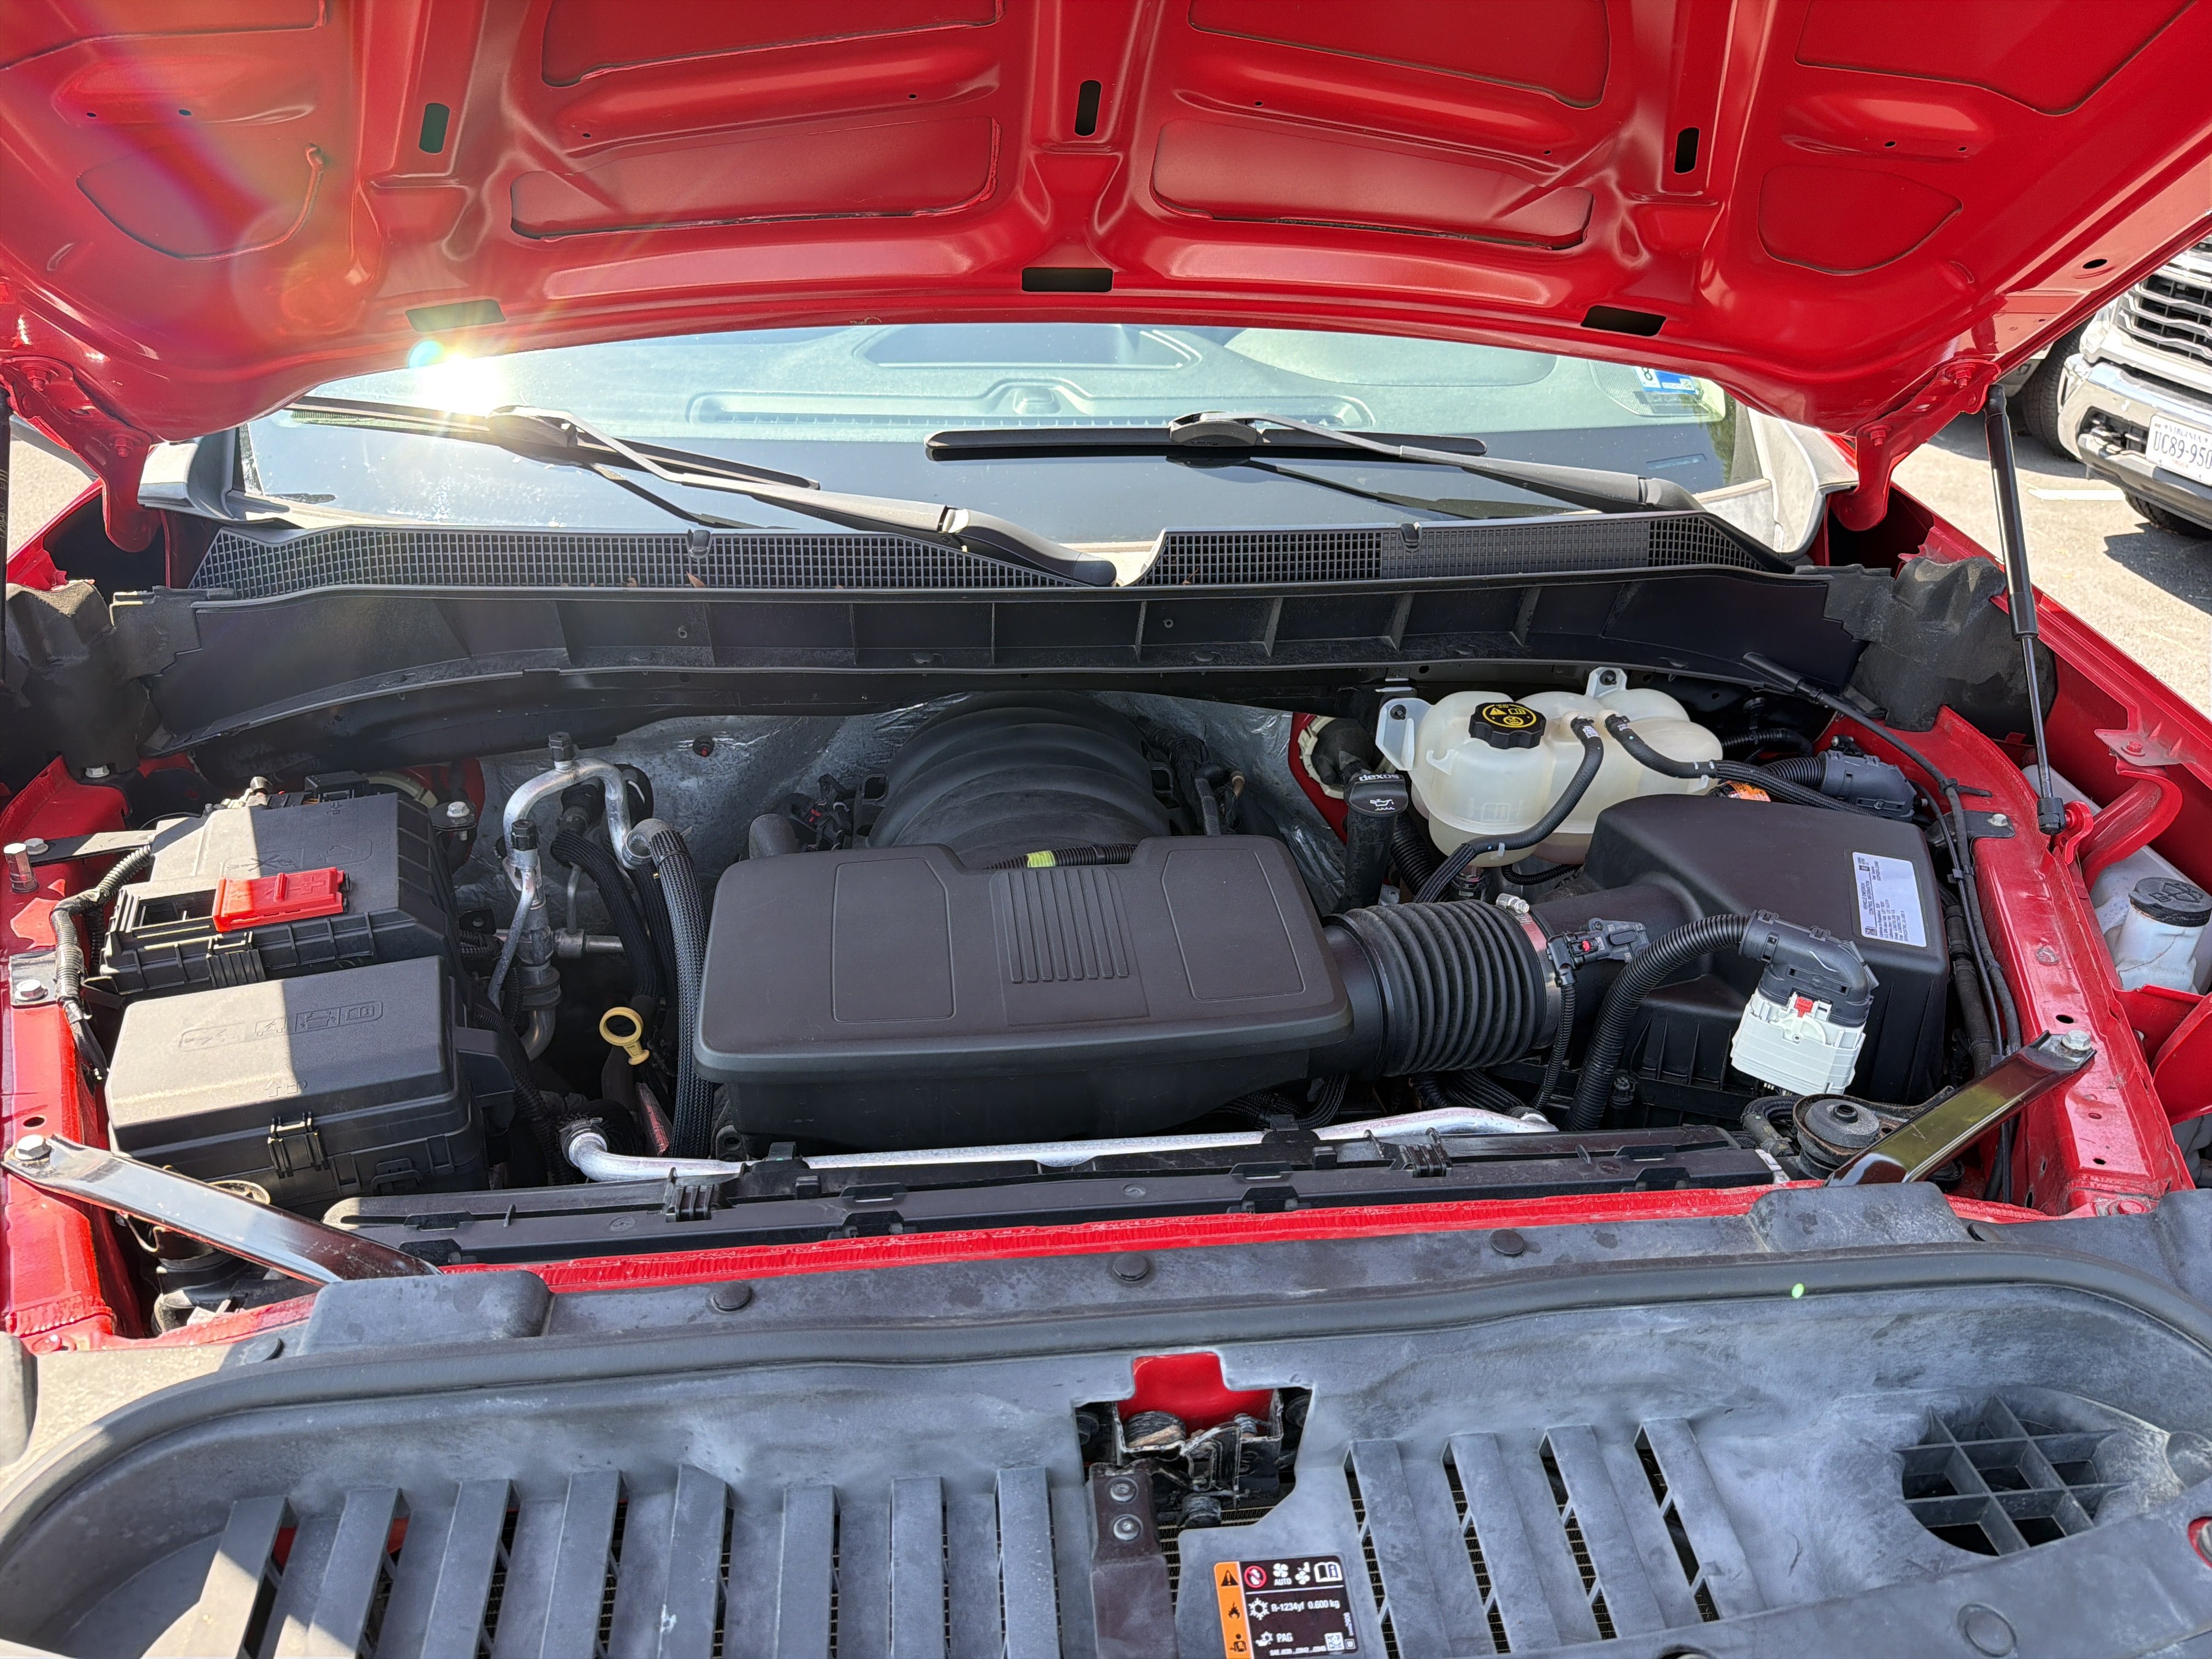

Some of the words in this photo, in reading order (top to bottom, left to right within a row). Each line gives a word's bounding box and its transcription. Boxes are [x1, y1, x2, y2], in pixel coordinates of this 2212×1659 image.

[1358, 774, 1400, 782] dexos
[1273, 1578, 1292, 1586] AUTO
[1271, 1601, 1305, 1612] R-1234yf
[1307, 1600, 1329, 1609] 0.600
[1329, 1599, 1340, 1609] kg
[1276, 1633, 1294, 1643] PAG
